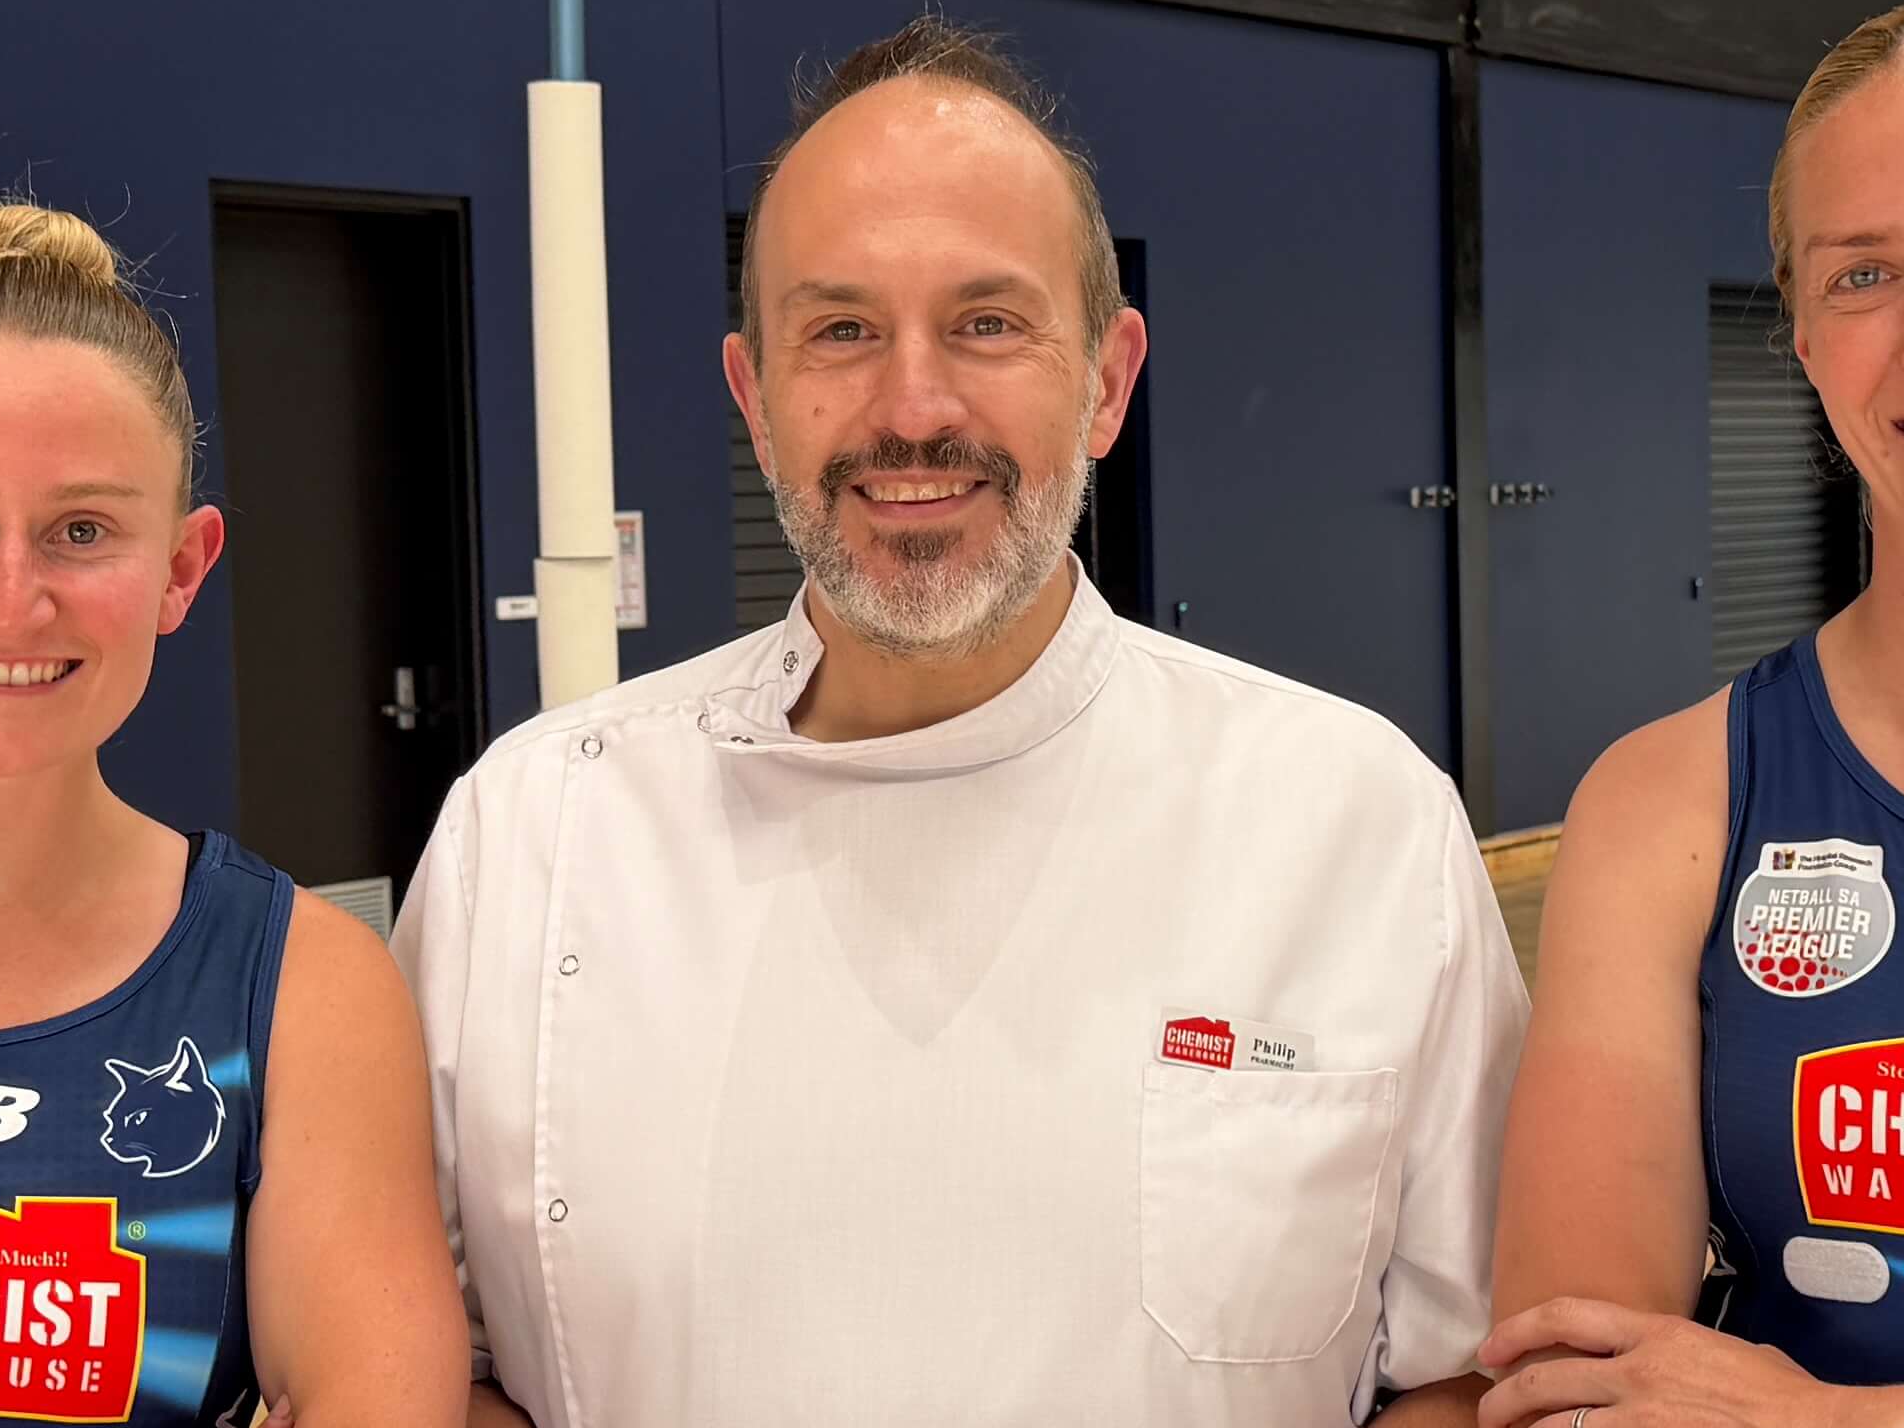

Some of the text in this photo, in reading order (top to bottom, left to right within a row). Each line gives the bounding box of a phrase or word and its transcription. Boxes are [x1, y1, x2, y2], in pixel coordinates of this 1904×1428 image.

[1768, 887, 1860, 907] NETBALL SA
[1749, 904, 1871, 935] PREMIER
[1757, 932, 1856, 959] LEAGUE
[1166, 1026, 1232, 1054] CHEMIST
[1252, 1037, 1296, 1061] Philip
[0, 1248, 69, 1269] Much!!
